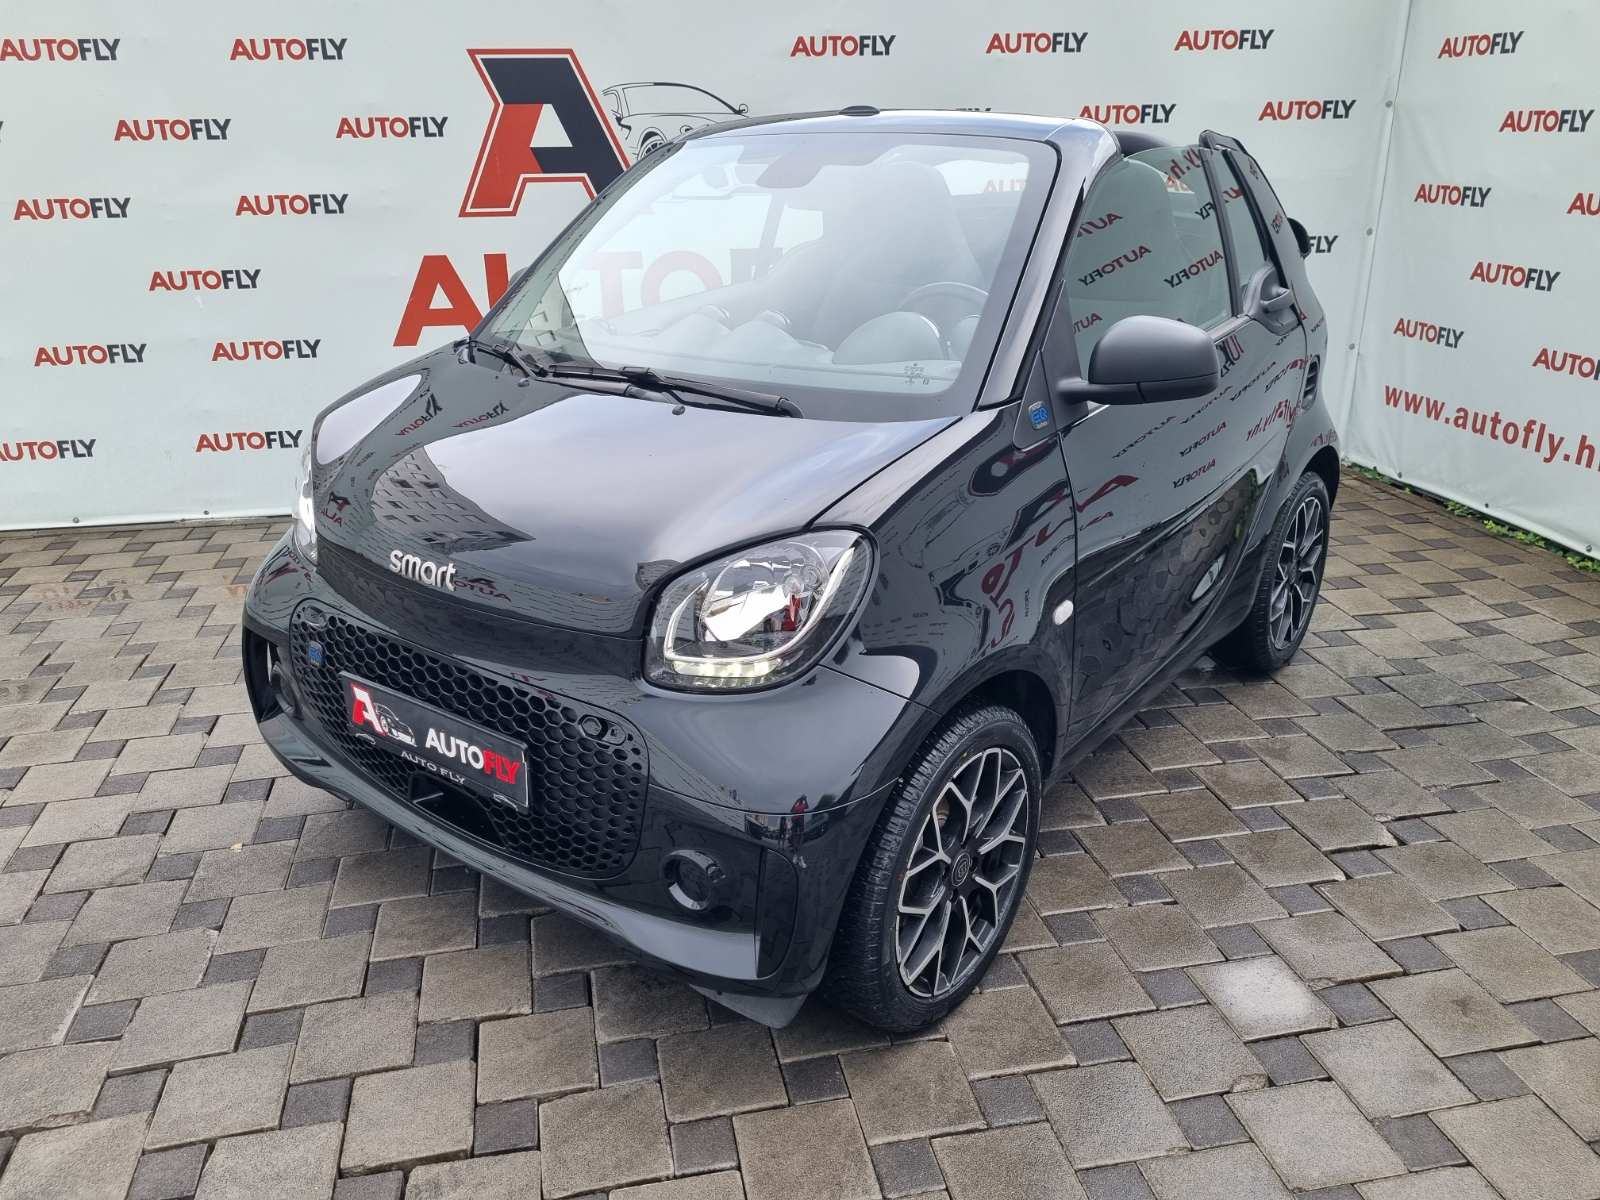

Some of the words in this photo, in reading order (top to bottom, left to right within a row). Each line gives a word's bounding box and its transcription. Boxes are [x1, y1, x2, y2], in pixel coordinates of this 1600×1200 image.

[0, 38, 120, 61] AUTOFLY
[230, 38, 347, 60] AUTOFLY
[791, 35, 896, 57] AUTOFLY
[986, 32, 1088, 54] AUTOFLY
[1174, 29, 1275, 51] AUTOFLY
[1438, 31, 1524, 59] AUTOFLY
[1079, 103, 1176, 125] AUTOFLY
[1259, 99, 1356, 121] AUTOFLY
[1499, 109, 1594, 133] AUTOFLY
[114, 118, 231, 141] AUTOFLY
[336, 116, 448, 139] AUTOFLY
[235, 193, 349, 216] AUTOFLY
[1414, 183, 1491, 208] AUTOFLY
[13, 197, 131, 220] AUTOFLY
[149, 269, 261, 291] AUTOFLY
[1470, 261, 1562, 292] AUTOFLY
[1393, 318, 1464, 348] AUTOFLY
[34, 343, 147, 367] AUTOFLY
[211, 339, 321, 361] AUTOFLY
[1384, 384, 1600, 473] www.autofly.h
[195, 430, 303, 453] AUTOFLY
[389, 549, 457, 591] smart
[425, 727, 521, 784] AUTOFLY
[401, 750, 438, 772] AUTO
[439, 767, 466, 785] FLY
